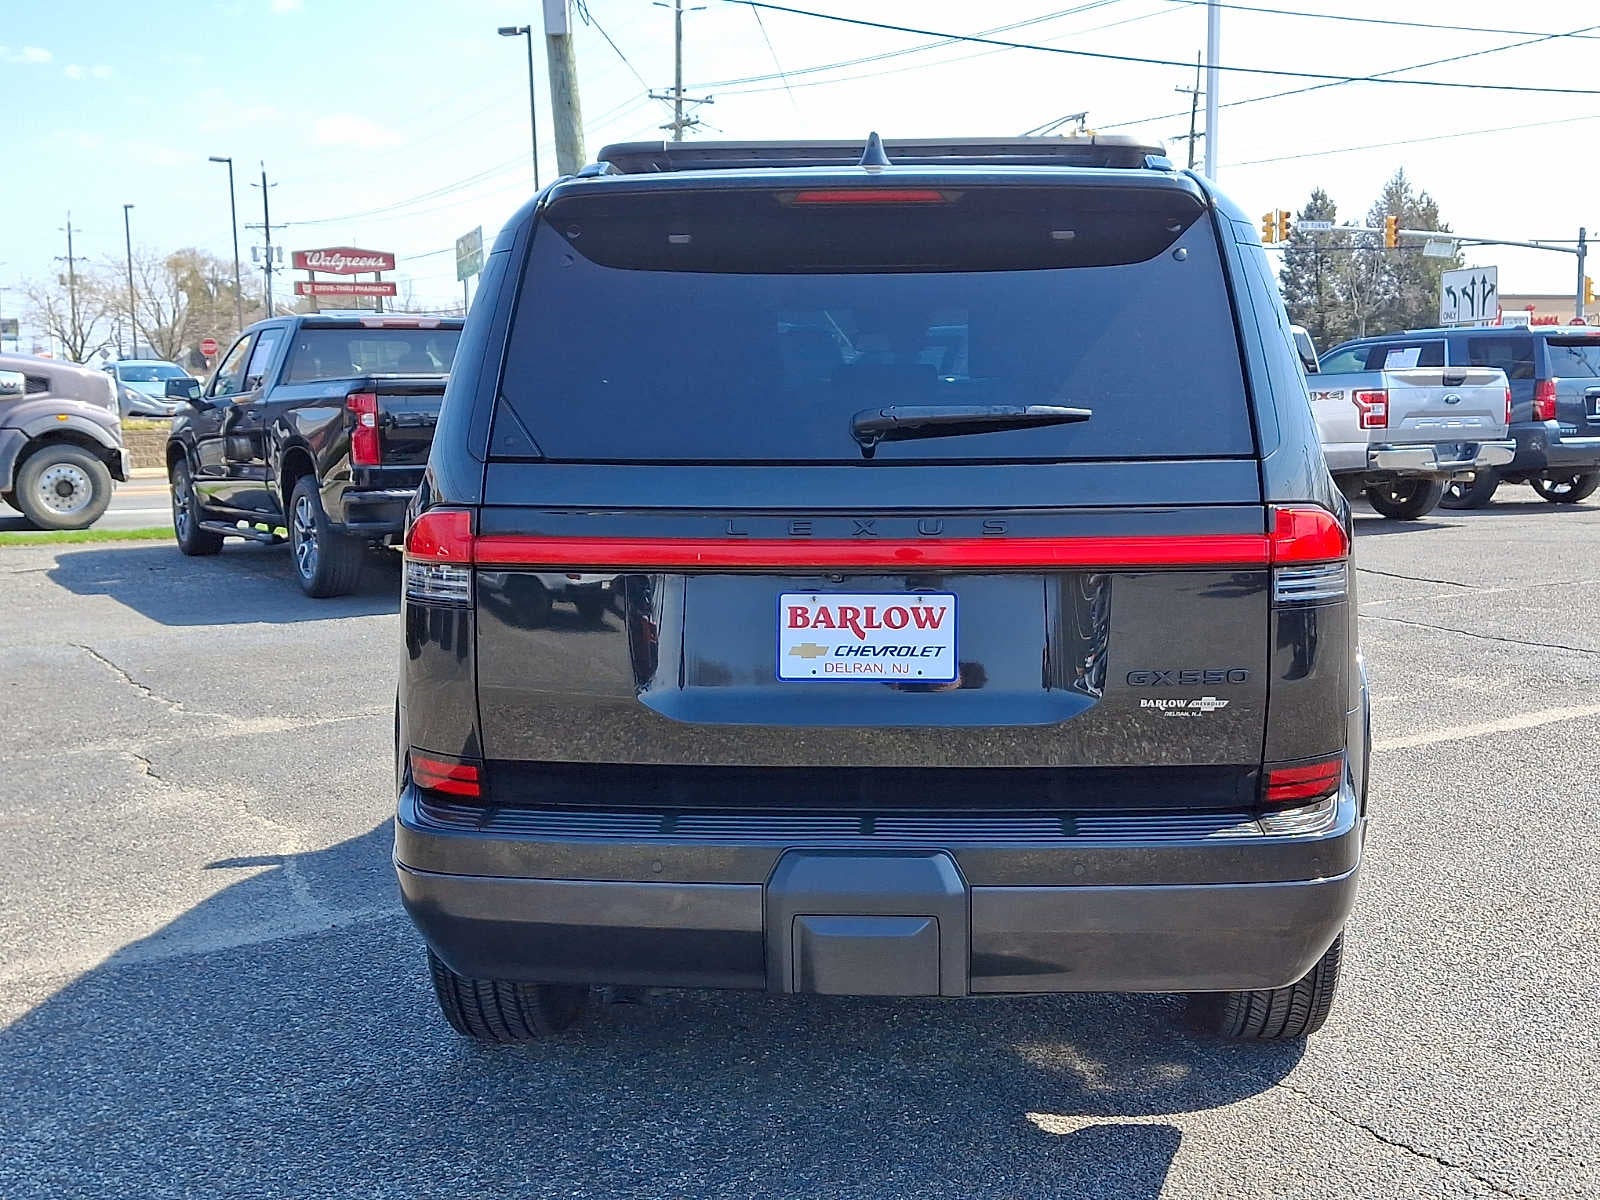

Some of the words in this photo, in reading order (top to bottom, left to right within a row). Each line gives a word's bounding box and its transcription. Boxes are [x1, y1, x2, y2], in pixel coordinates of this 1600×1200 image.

[304, 251, 387, 270] Walgreens
[1442, 311, 1457, 321] ONLY
[726, 519, 1009, 537] LEXUS
[787, 606, 947, 641] BARLOW
[834, 645, 947, 658] CHEVROLET
[824, 662, 887, 675] DELRAN,
[892, 662, 909, 674] NJ
[1126, 668, 1249, 687] GX550
[1140, 699, 1188, 711] BARLOW
